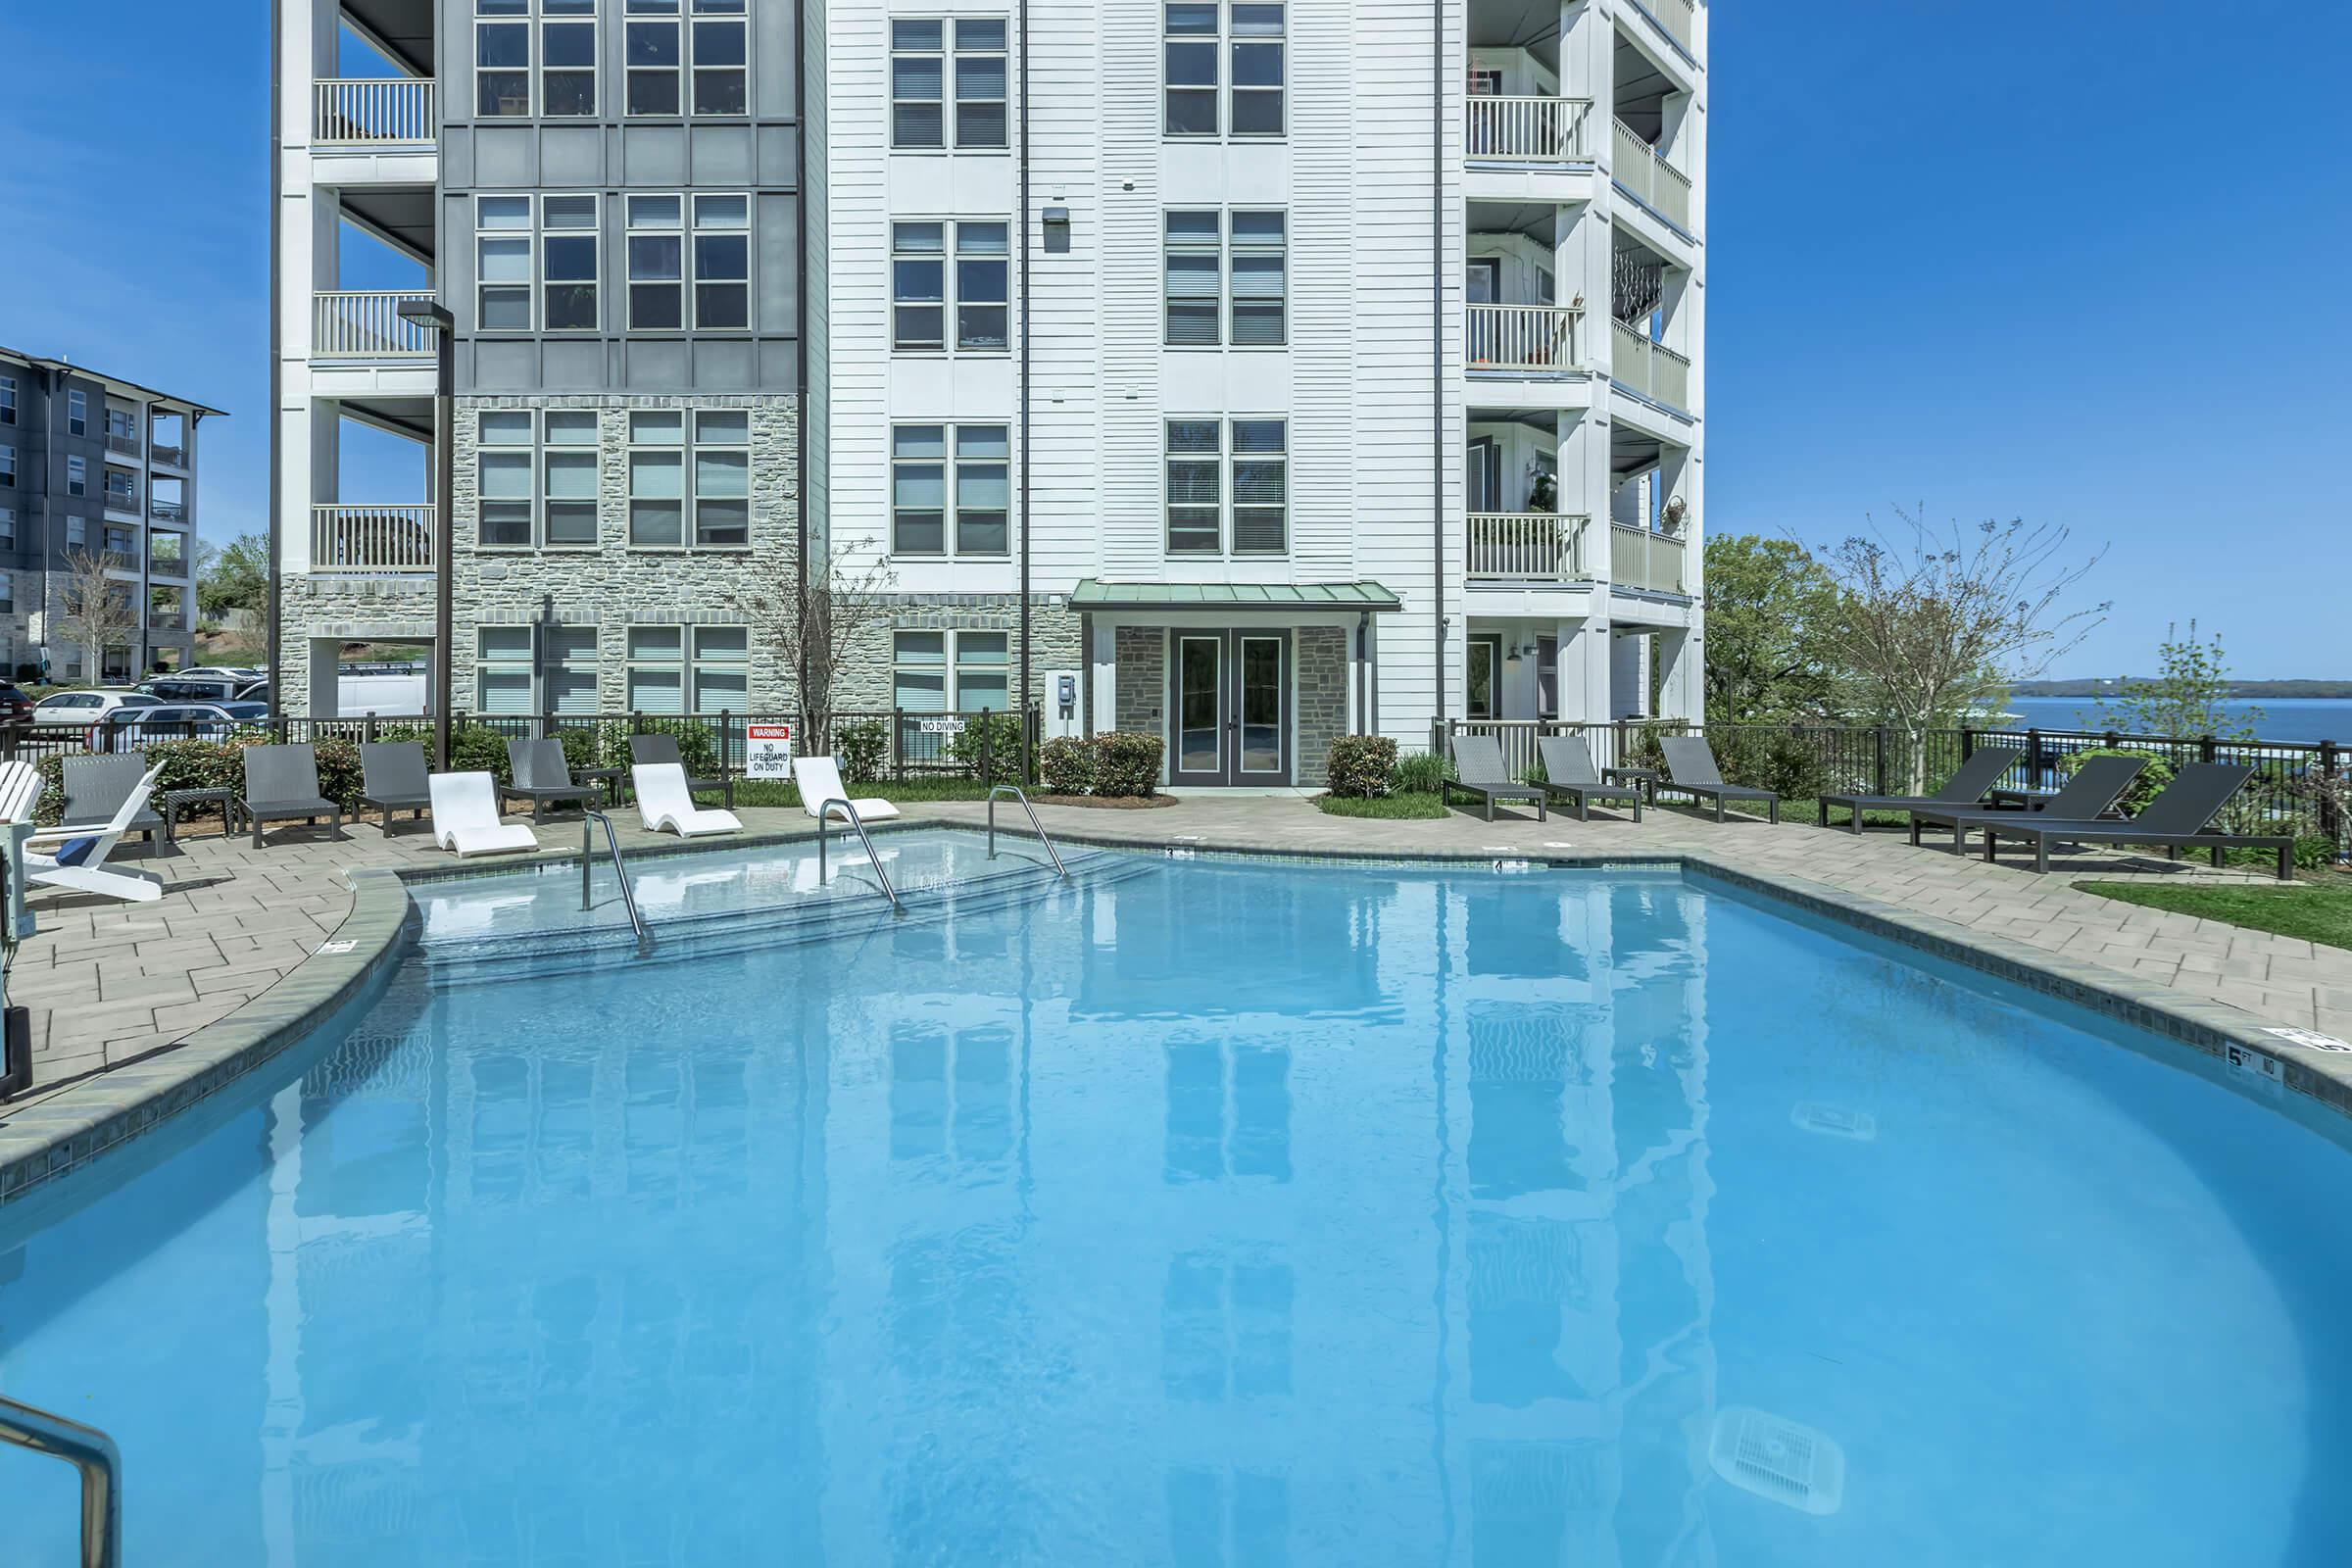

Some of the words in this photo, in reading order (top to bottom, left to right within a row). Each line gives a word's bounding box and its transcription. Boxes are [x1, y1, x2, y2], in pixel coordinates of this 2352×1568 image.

[922, 721, 934, 731] NO
[936, 721, 963, 731] DIVING
[753, 728, 785, 737] WARNING
[763, 743, 774, 752] NO
[750, 753, 788, 761] LIFEGUARD
[754, 762, 763, 771] ON
[765, 762, 784, 771] DUTY
[2229, 1046, 2242, 1066] 5
